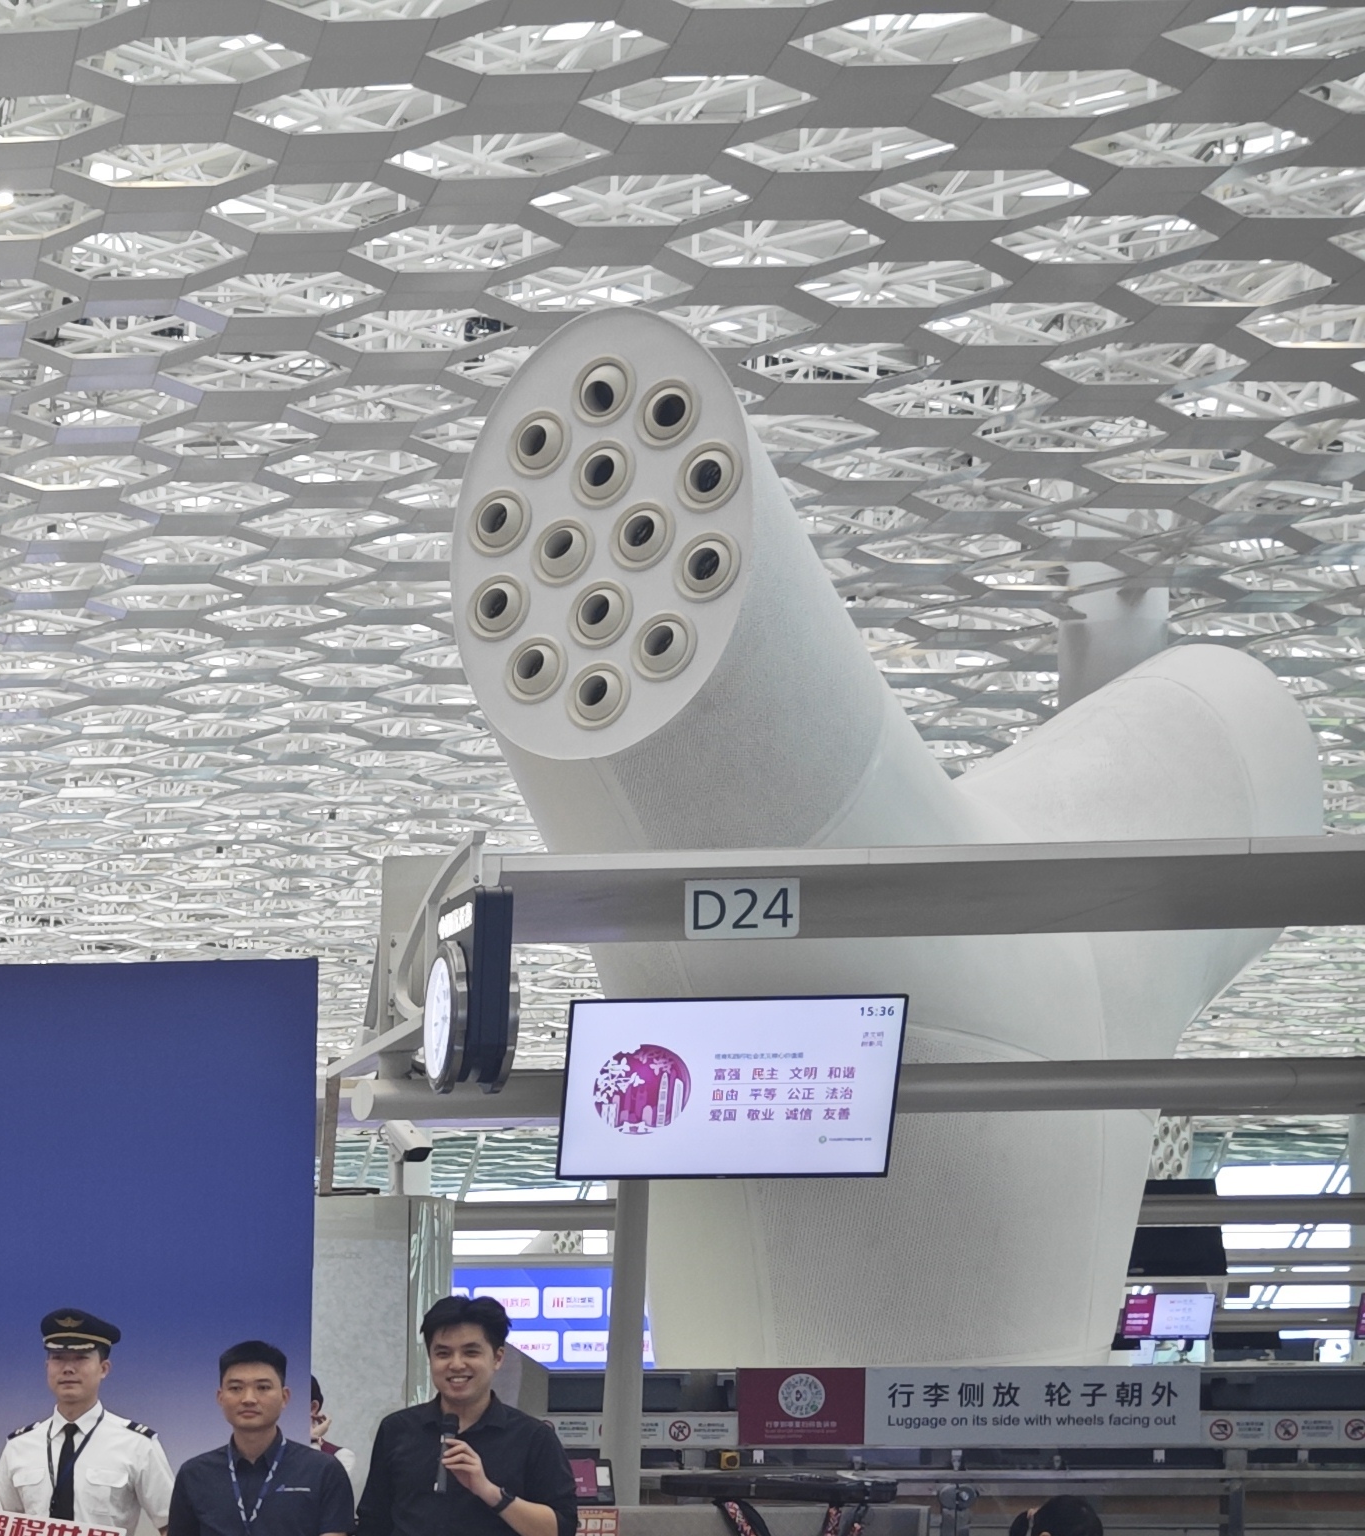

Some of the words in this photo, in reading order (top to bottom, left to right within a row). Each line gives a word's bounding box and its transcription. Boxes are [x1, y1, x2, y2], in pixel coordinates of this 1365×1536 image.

[693, 888, 794, 930] D24
[860, 1006, 896, 1017] 15:36
[713, 1068, 741, 1082] 富强
[752, 1067, 779, 1081] 民主
[789, 1066, 818, 1080] 文明
[827, 1065, 856, 1080] 和谐
[748, 1087, 777, 1101] 平等
[787, 1087, 815, 1100] 公正
[825, 1086, 854, 1100] 法治
[708, 1108, 737, 1121] 爱国
[746, 1108, 775, 1121] 敬业
[784, 1107, 813, 1121] 诚信
[822, 1107, 851, 1121] 友善
[887, 1382, 1021, 1409] 行李侧放
[1044, 1381, 1179, 1408] 轮子朝外
[887, 1414, 947, 1429] Luggage
[951, 1417, 968, 1427] on
[972, 1414, 988, 1427] its
[991, 1413, 1021, 1427] side
[1024, 1413, 1052, 1426] with
[1055, 1413, 1105, 1426] wheels
[1108, 1413, 1150, 1429] facing
[1154, 1414, 1177, 1426] out
